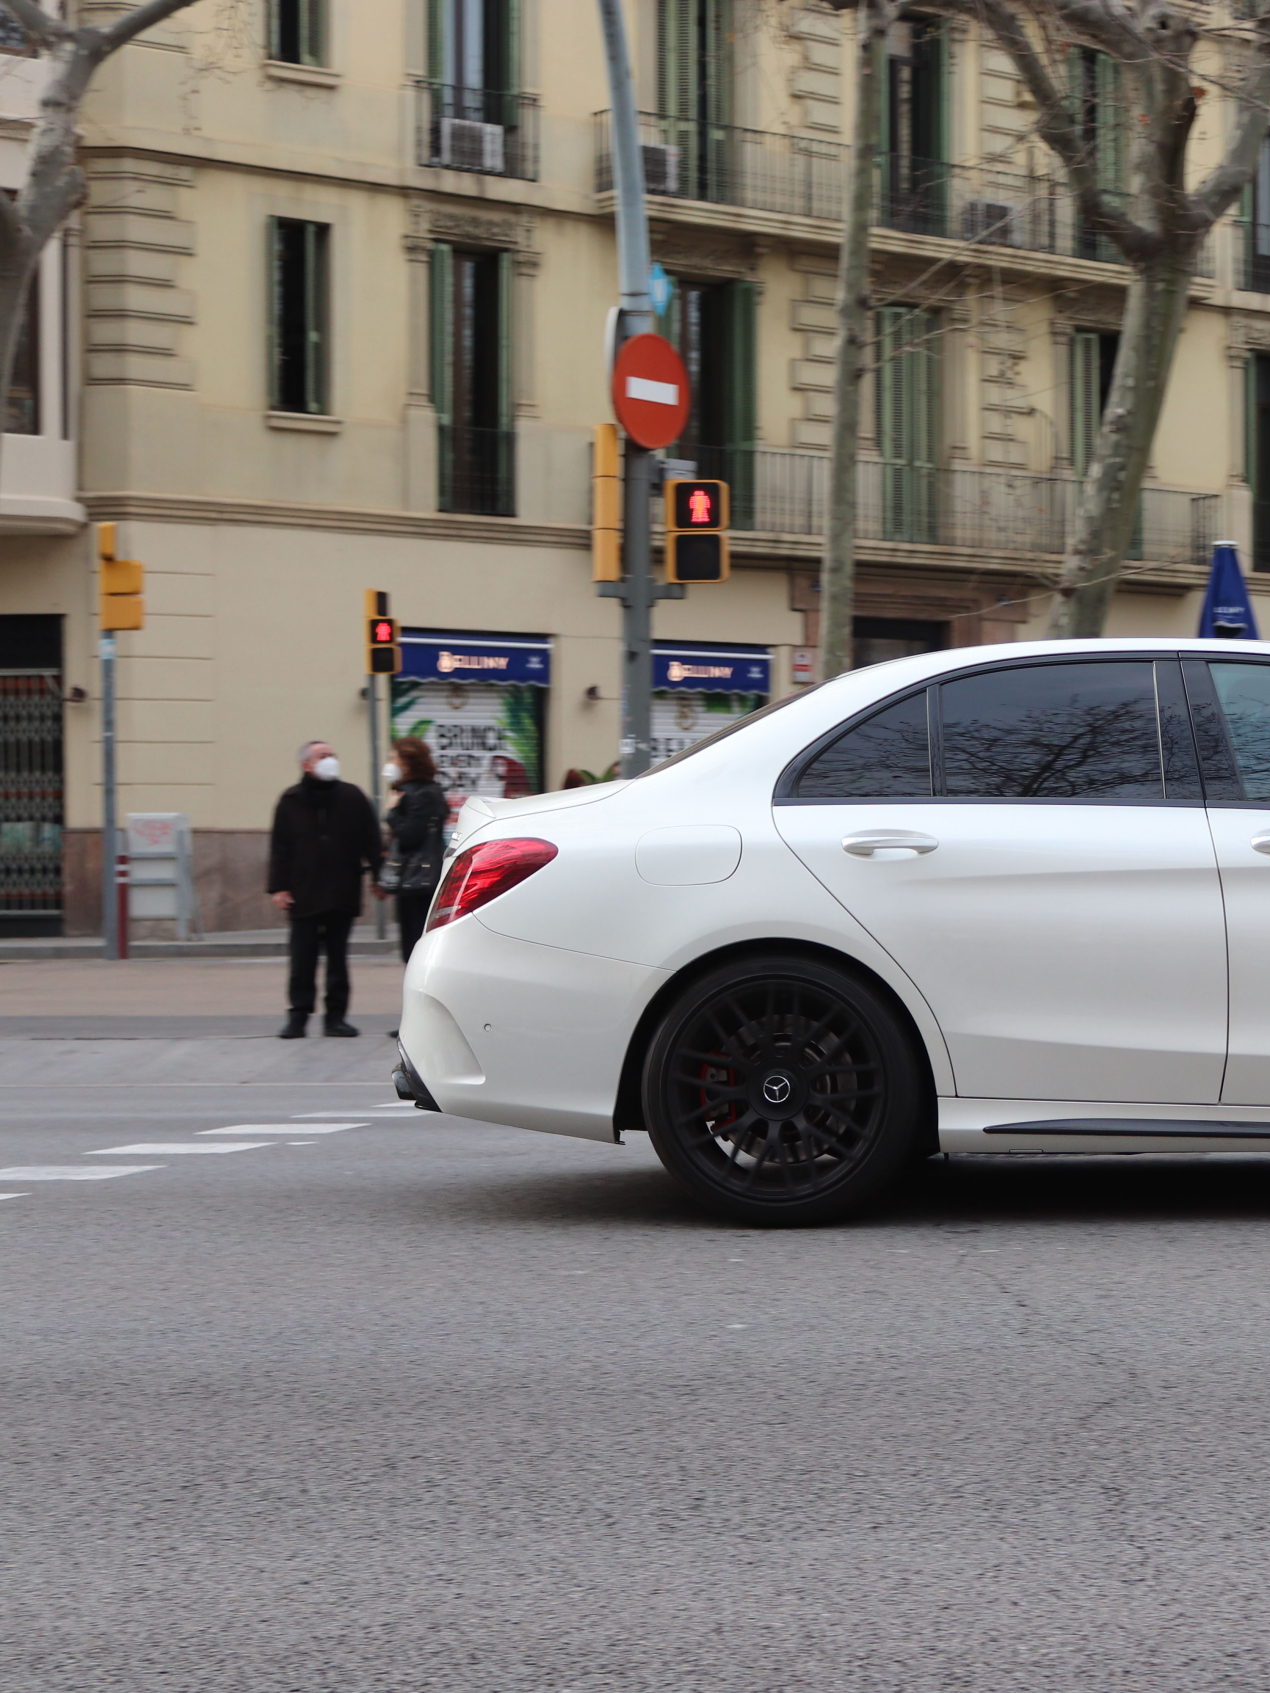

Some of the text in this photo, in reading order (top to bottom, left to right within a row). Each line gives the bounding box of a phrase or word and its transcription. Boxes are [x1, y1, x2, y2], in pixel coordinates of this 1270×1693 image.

[436, 725, 506, 751] BRUNCH
[437, 754, 482, 768] EVERY
[434, 770, 478, 792] DAY
